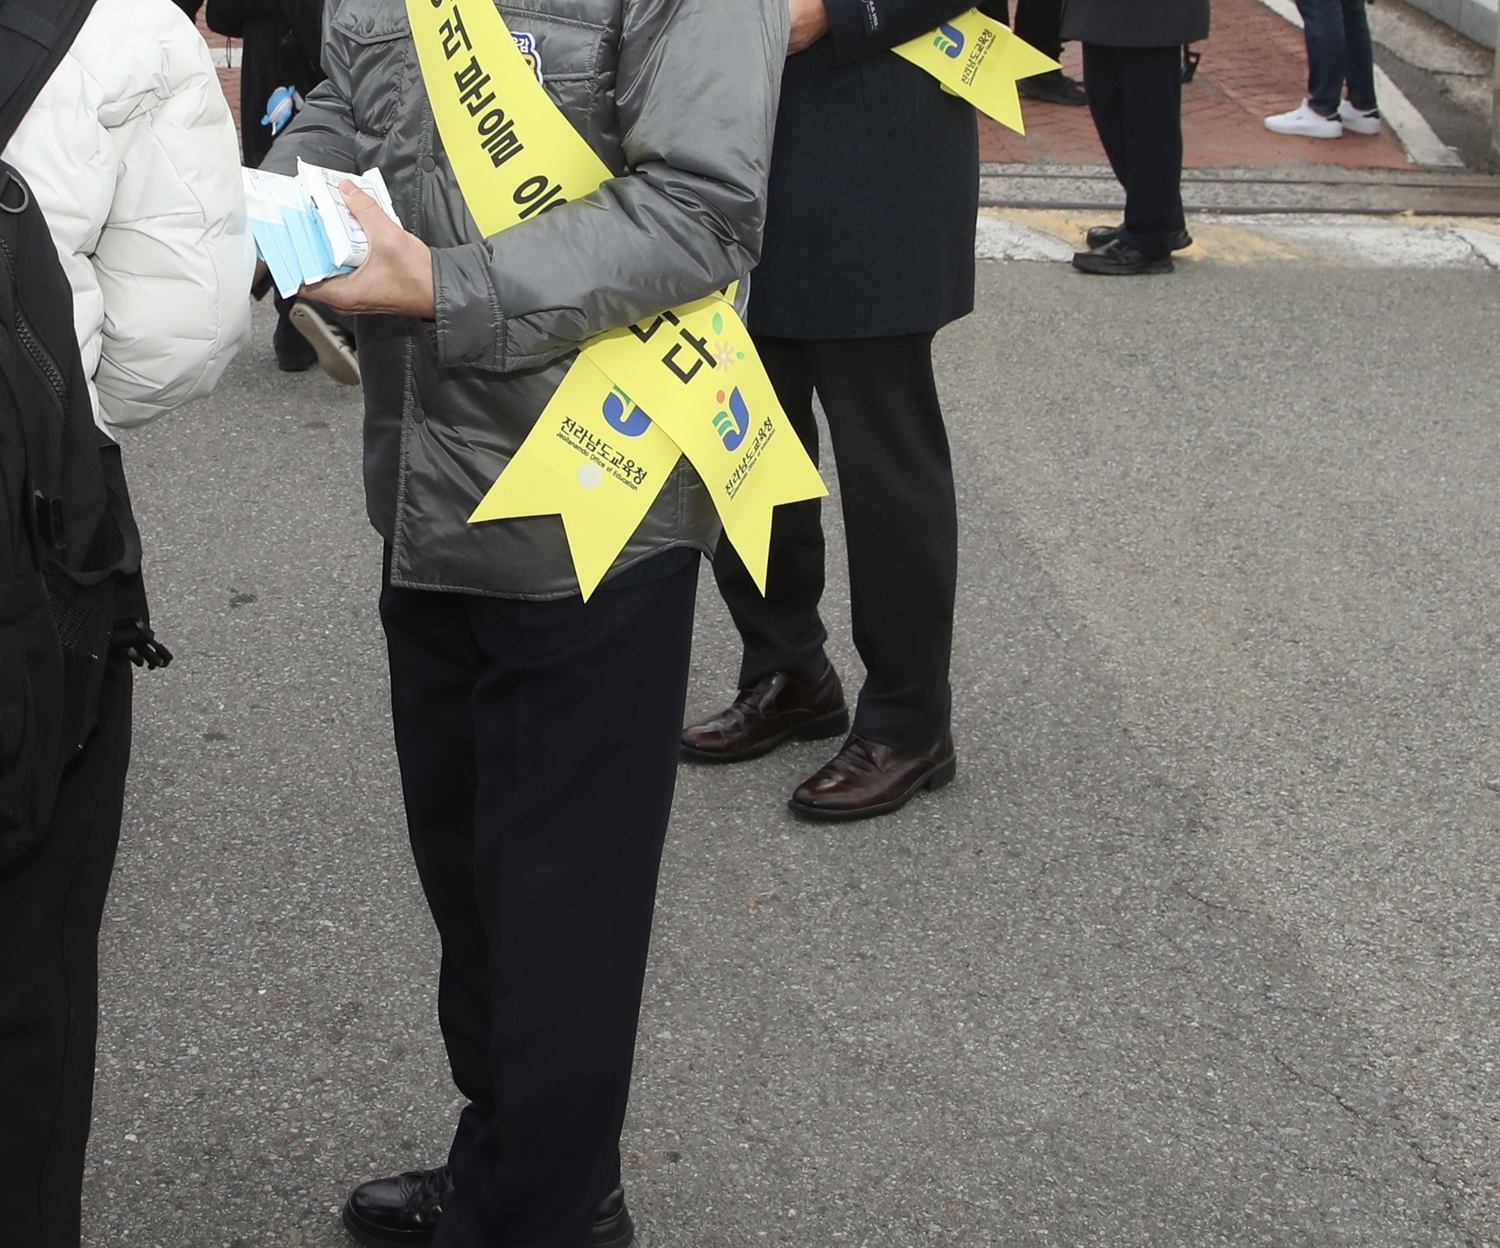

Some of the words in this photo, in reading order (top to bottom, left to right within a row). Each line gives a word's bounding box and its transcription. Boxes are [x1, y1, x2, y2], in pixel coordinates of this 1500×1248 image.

[561, 416, 648, 486] 전라남도교육청
[590, 454, 605, 468] Office
[612, 470, 638, 492] Education
[724, 416, 774, 497] 전라남도교육청
